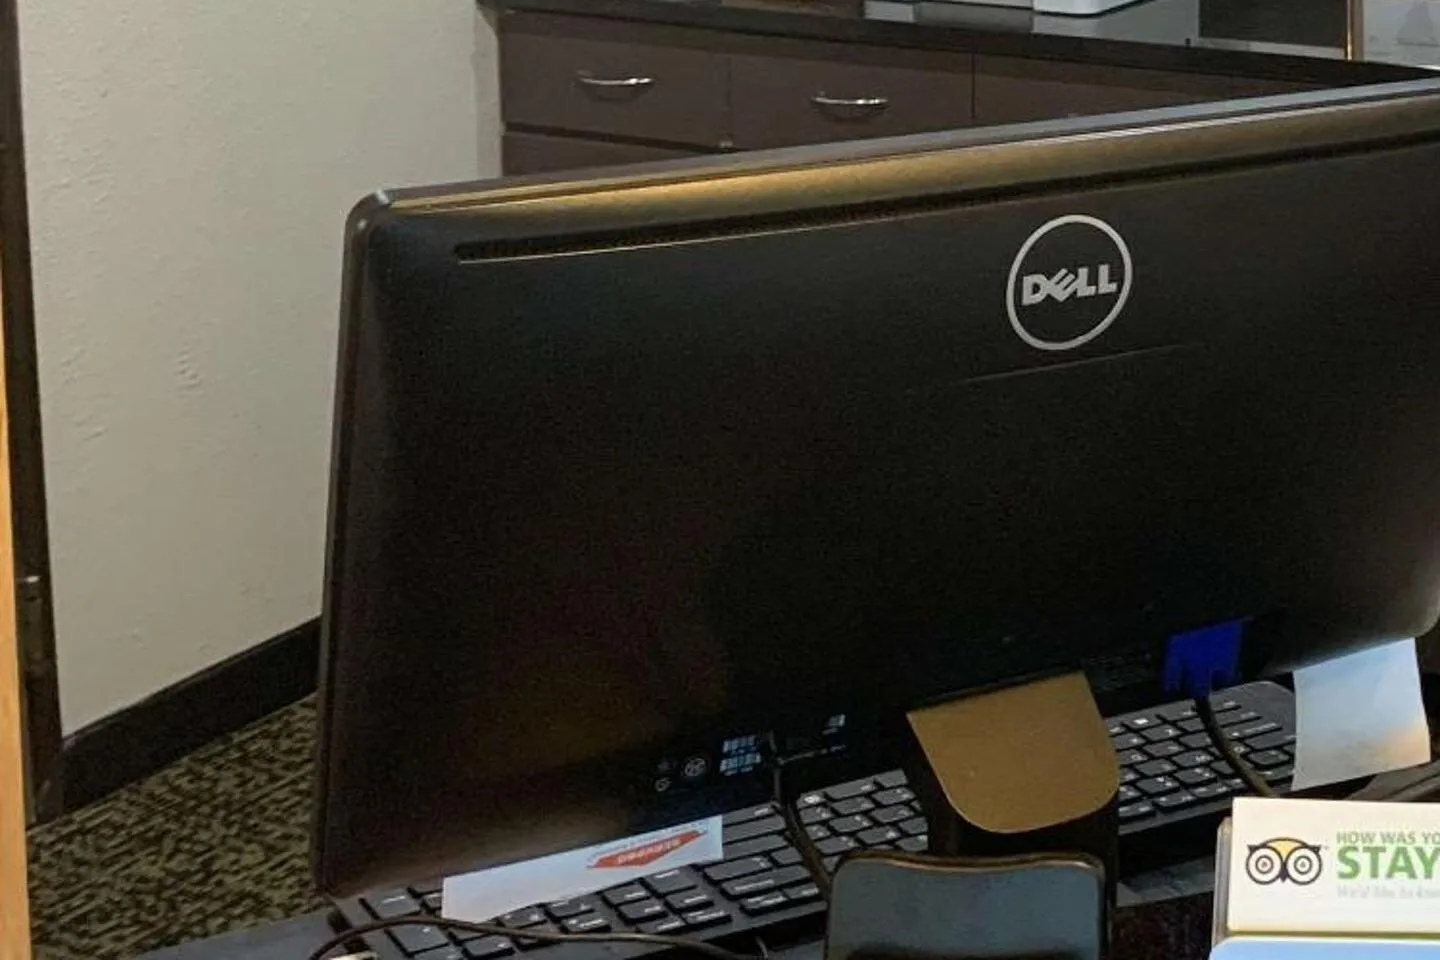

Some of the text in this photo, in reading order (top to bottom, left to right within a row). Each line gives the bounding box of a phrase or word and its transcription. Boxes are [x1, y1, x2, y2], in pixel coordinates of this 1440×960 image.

[1022, 263, 1118, 306] DELL
[1336, 831, 1376, 844] HOW
[1380, 831, 1416, 845] WAS
